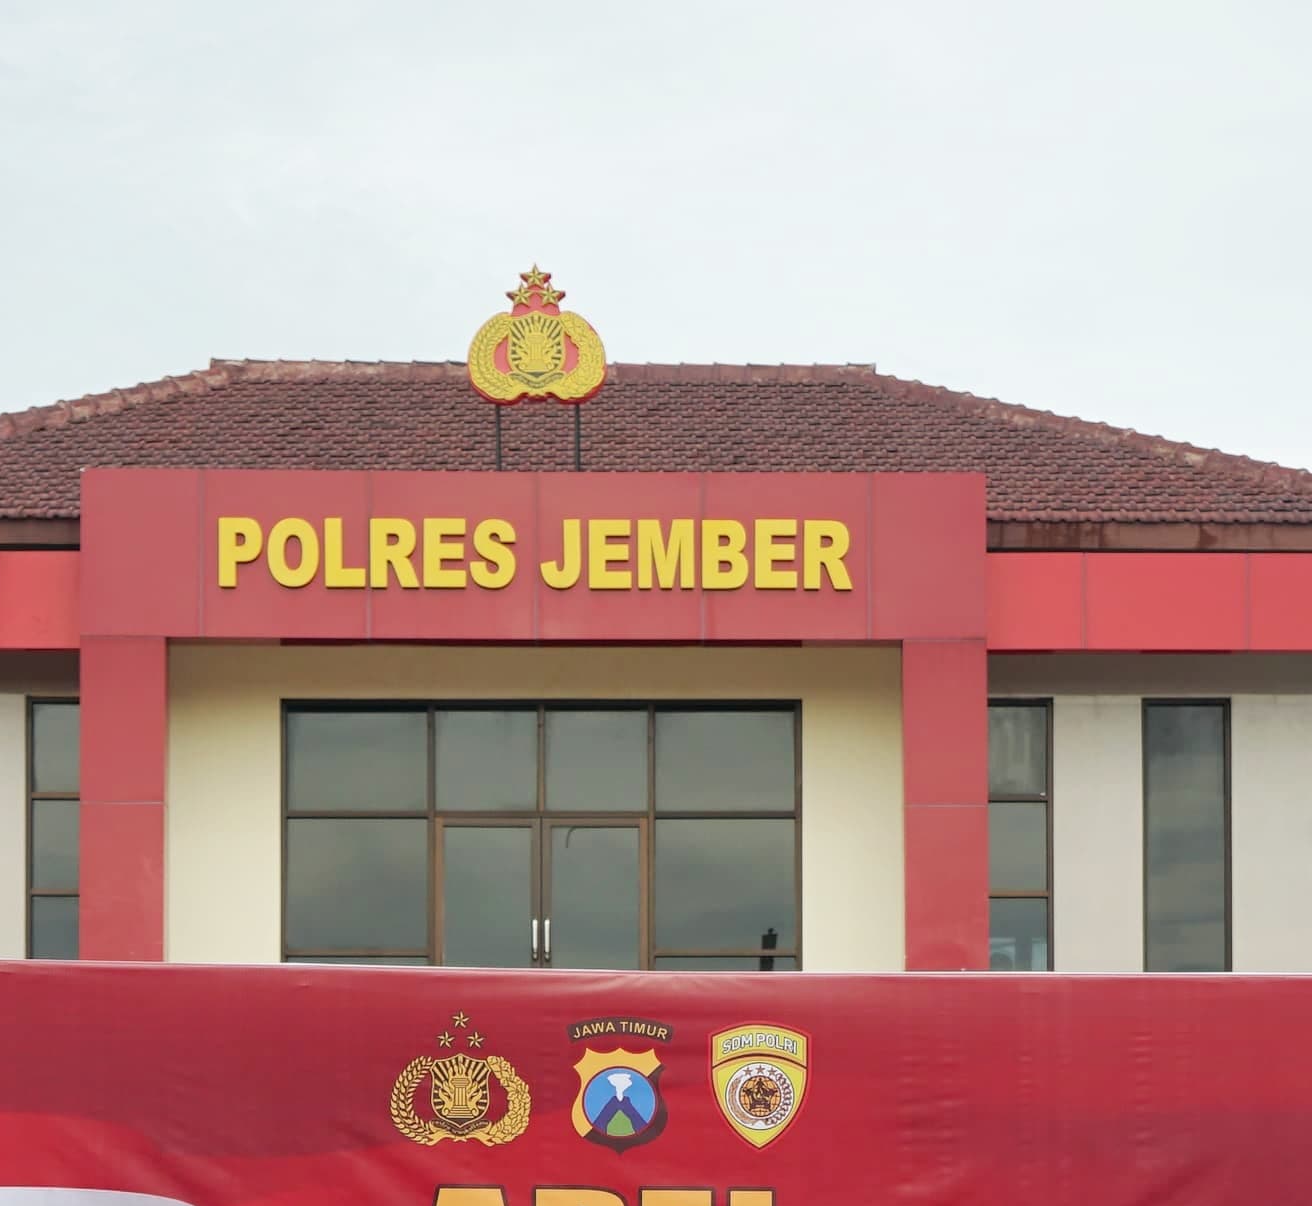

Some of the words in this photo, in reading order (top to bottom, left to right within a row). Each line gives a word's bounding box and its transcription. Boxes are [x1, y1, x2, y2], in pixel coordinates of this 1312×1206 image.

[217, 516, 518, 590] POLRES
[540, 518, 853, 592] JEMBER
[573, 1021, 616, 1039] JAWA
[620, 1021, 669, 1040] TIMUR
[722, 1033, 754, 1055] SDM
[754, 1034, 798, 1055] POLRI
